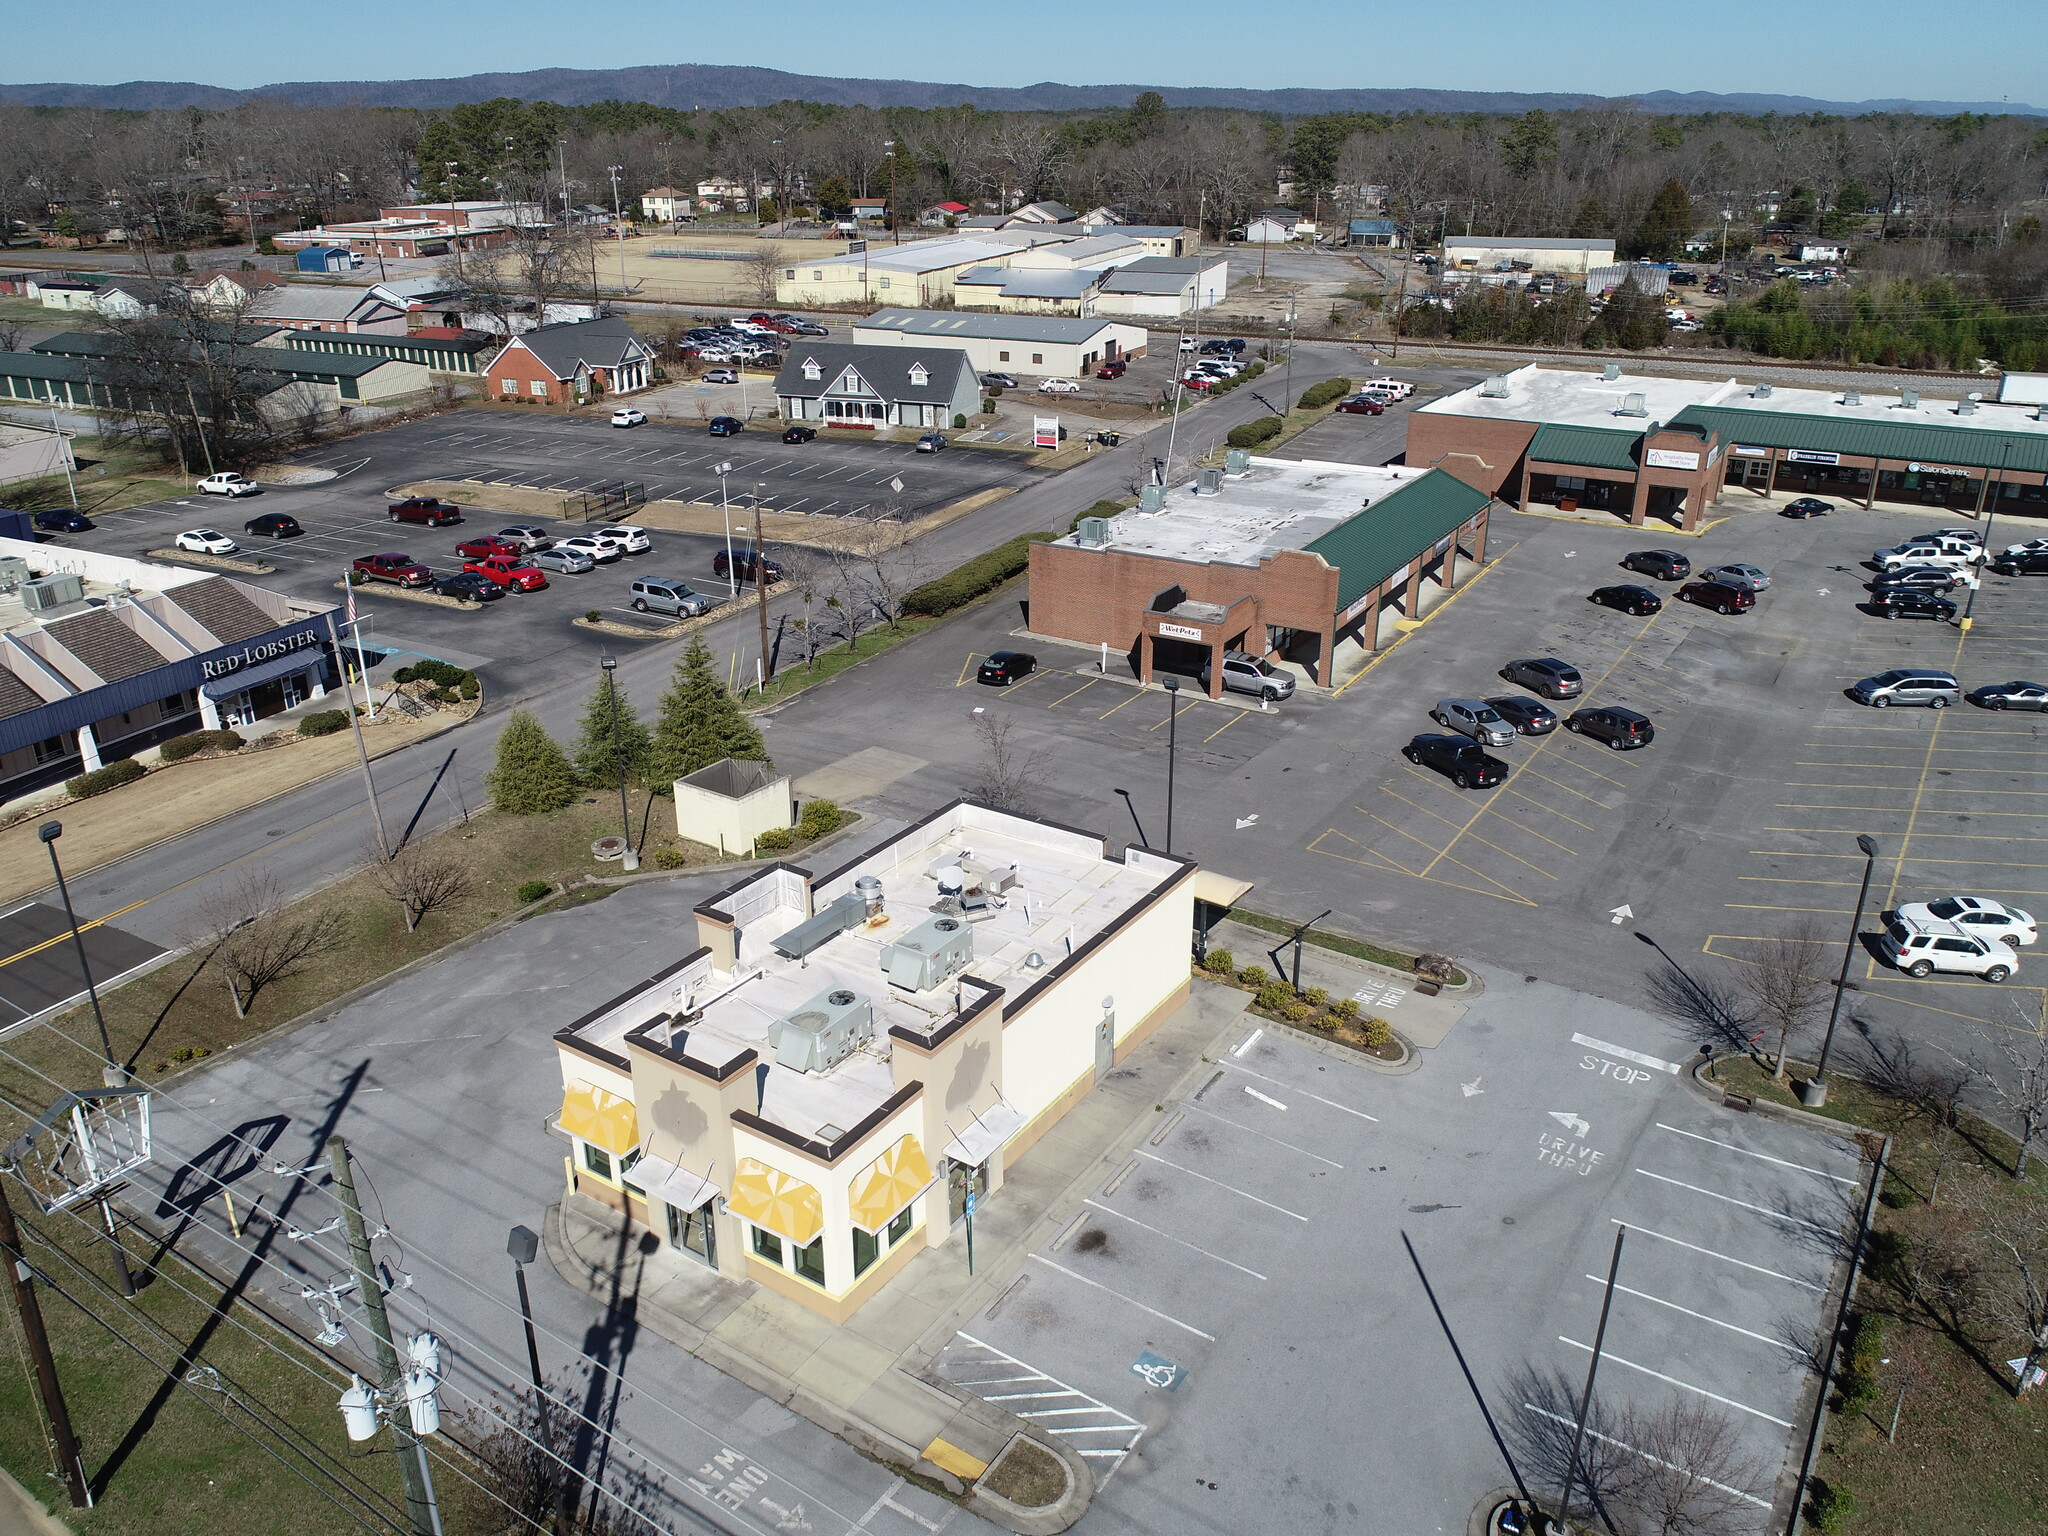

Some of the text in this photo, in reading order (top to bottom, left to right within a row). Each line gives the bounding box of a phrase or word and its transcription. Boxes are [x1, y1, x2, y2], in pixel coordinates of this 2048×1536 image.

[1920, 464, 1972, 477] SalonCentric
[201, 629, 317, 679] RED LOBSTER
[1352, 980, 1386, 1005] DRIVE
[1375, 987, 1407, 1009] THRU
[1579, 1055, 1652, 1084] STOP
[1538, 1132, 1605, 1164] DRIVE
[1538, 1148, 1592, 1176] THRU
[688, 1447, 745, 1496] WAY
[714, 1466, 769, 1511] ONE
